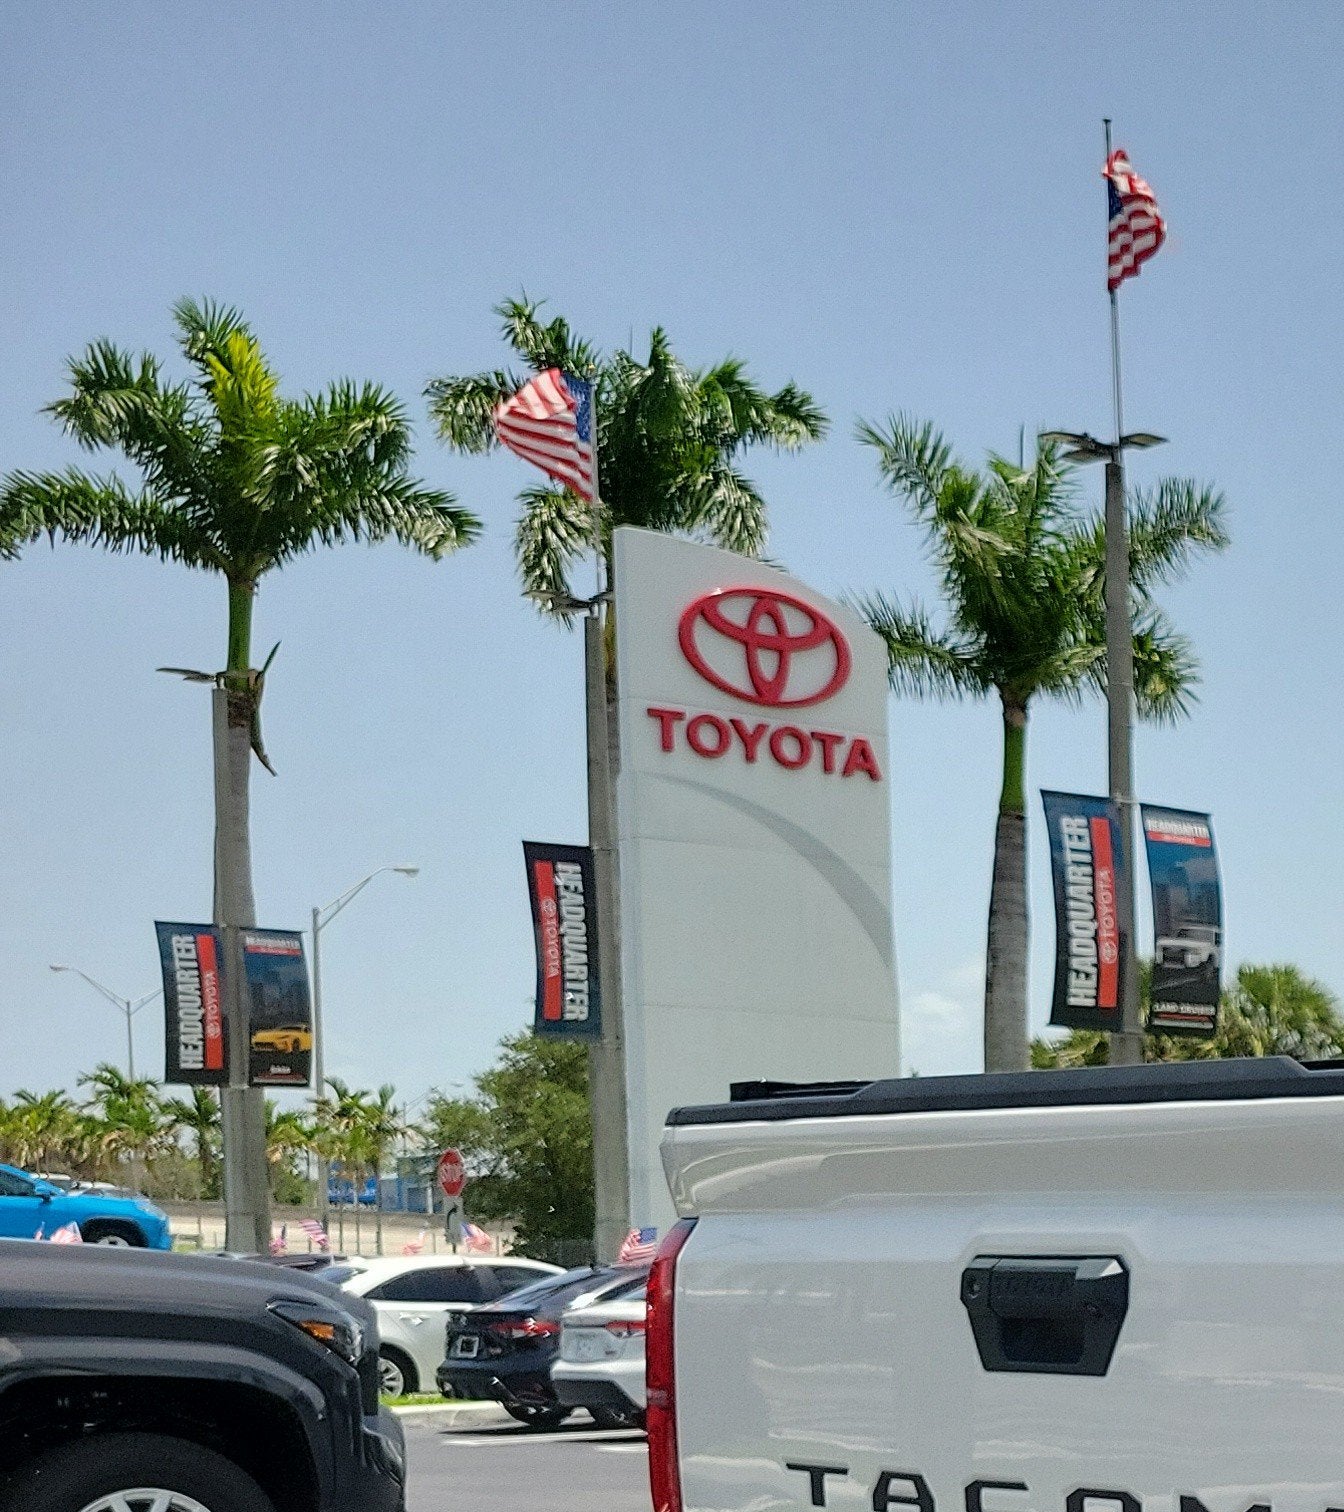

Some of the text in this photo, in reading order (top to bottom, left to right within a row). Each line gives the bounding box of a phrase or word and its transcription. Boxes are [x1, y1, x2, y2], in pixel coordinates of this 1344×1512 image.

[647, 708, 882, 782] TOYOTA
[555, 861, 590, 1021] HEADQUARTER
[1062, 816, 1098, 1007] HEADQUARTER
[1098, 870, 1116, 939] TOYOTA
[545, 917, 560, 977] TOYOTA
[172, 934, 205, 1070] HEADQUARTER
[441, 1163, 463, 1182] STOP
